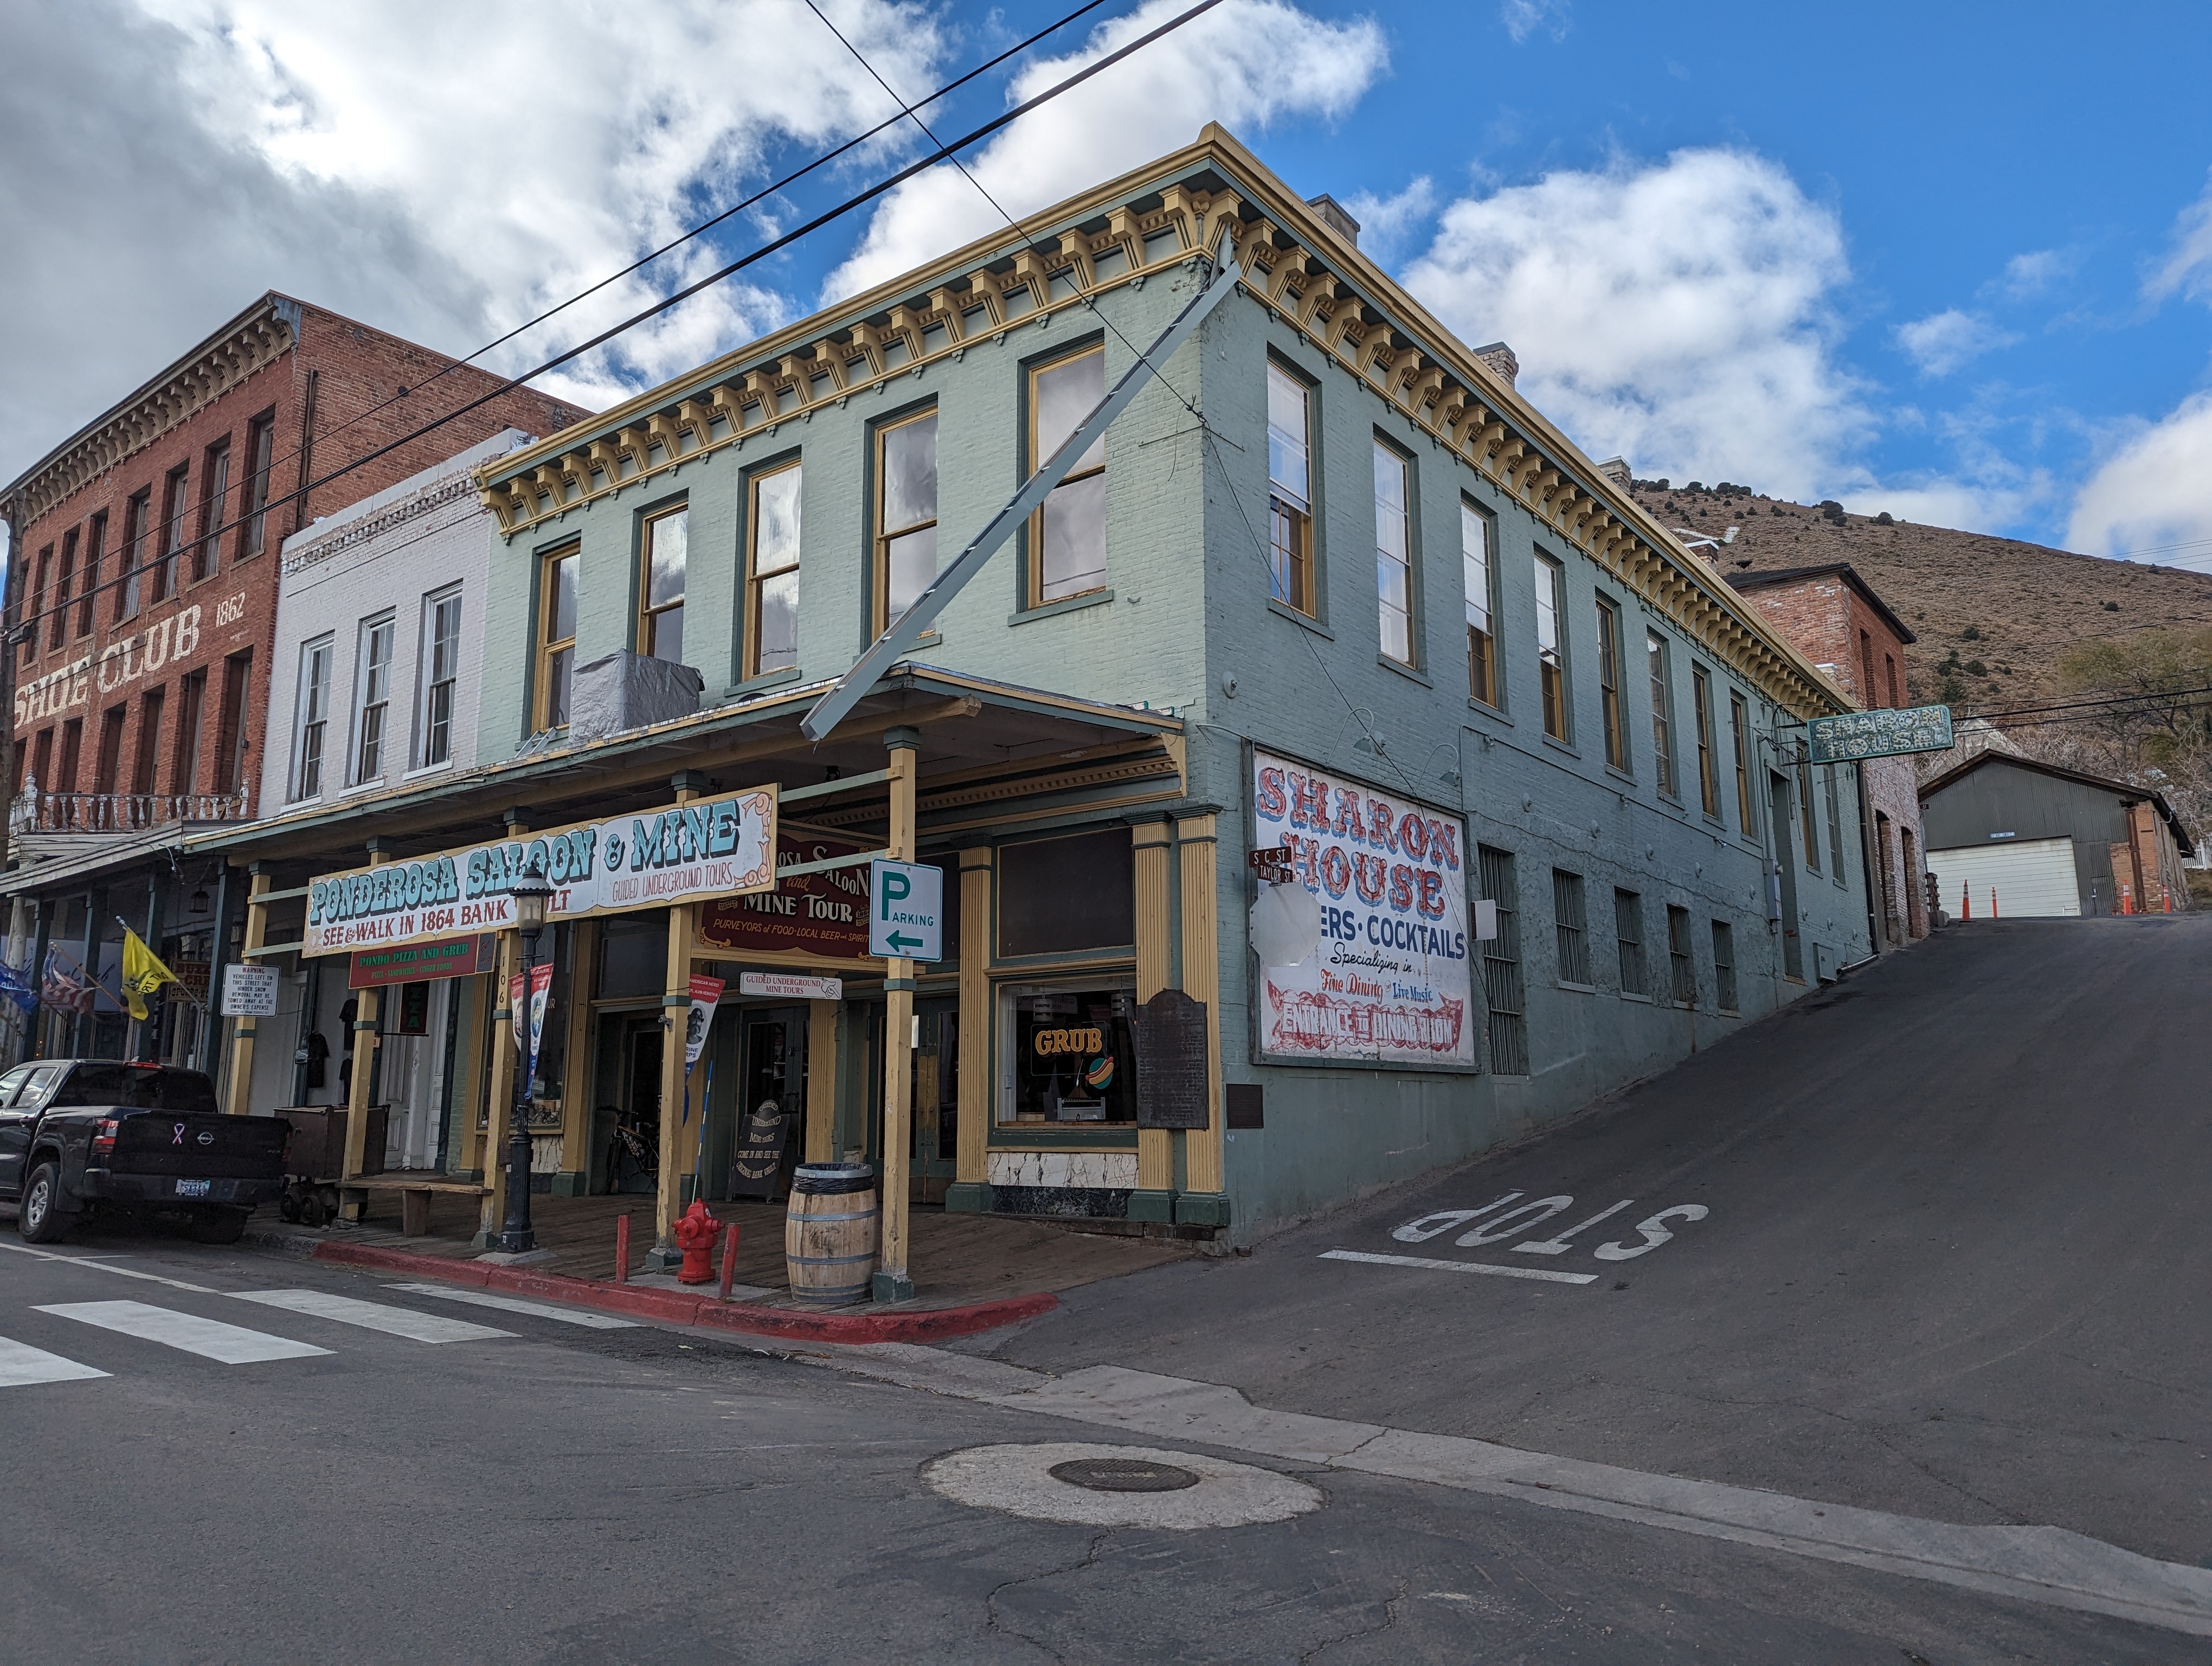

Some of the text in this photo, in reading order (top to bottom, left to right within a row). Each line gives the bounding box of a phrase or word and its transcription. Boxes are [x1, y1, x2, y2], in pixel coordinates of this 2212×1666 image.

[215, 592, 246, 628] 1862
[14, 604, 202, 730] SHOE CLUB
[1816, 707, 1941, 739] SHARON
[1827, 729, 1933, 759] HOUSE
[1256, 766, 1459, 874] SHARON
[310, 799, 741, 926] PONDEROSA SALOON & MINE
[1254, 849, 1285, 864] S C ST
[613, 862, 734, 901] GUIDED UNDERGROUND TOURS
[1260, 865, 1290, 883] TAYLOR ST
[1279, 830, 1446, 920] HOUSE
[744, 892, 853, 922] MINE TOUR
[881, 870, 934, 927] PARKING
[323, 926, 344, 946] SEE
[356, 917, 395, 942] WALK
[400, 914, 415, 935] IN
[420, 908, 454, 932] 1864
[460, 900, 509, 926] BANK
[713, 919, 762, 933] PURVEYORS
[763, 924, 770, 933] of
[820, 931, 840, 940] BEER
[848, 933, 870, 943] SPIRIT
[1367, 915, 1466, 960] COCKTAILS
[359, 954, 390, 967] PONDO
[392, 950, 417, 964] PIZZA
[421, 947, 439, 960] AND
[442, 943, 469, 957] GRUB
[420, 964, 436, 973] FINGER
[437, 962, 452, 971] FOODS
[1330, 941, 1399, 975] Specializing
[746, 975, 821, 987] GUIDED UNDERGROUND
[766, 985, 782, 993] MINE
[1321, 968, 1343, 992] Fine
[1346, 972, 1383, 1005] Dining
[1393, 978, 1410, 1000] Live
[1410, 985, 1433, 1003] Music
[1281, 1003, 1353, 1035] ENTRANCE
[1034, 1028, 1103, 1055] GRUB
[759, 1102, 779, 1111] GUIDED
[749, 1132, 762, 1143] MINE
[736, 1161, 751, 1178] ORIGINAL
[751, 1170, 763, 1179] BANK
[503, 1235, 507, 1244] 72
[1391, 1192, 1709, 1261] STOP
